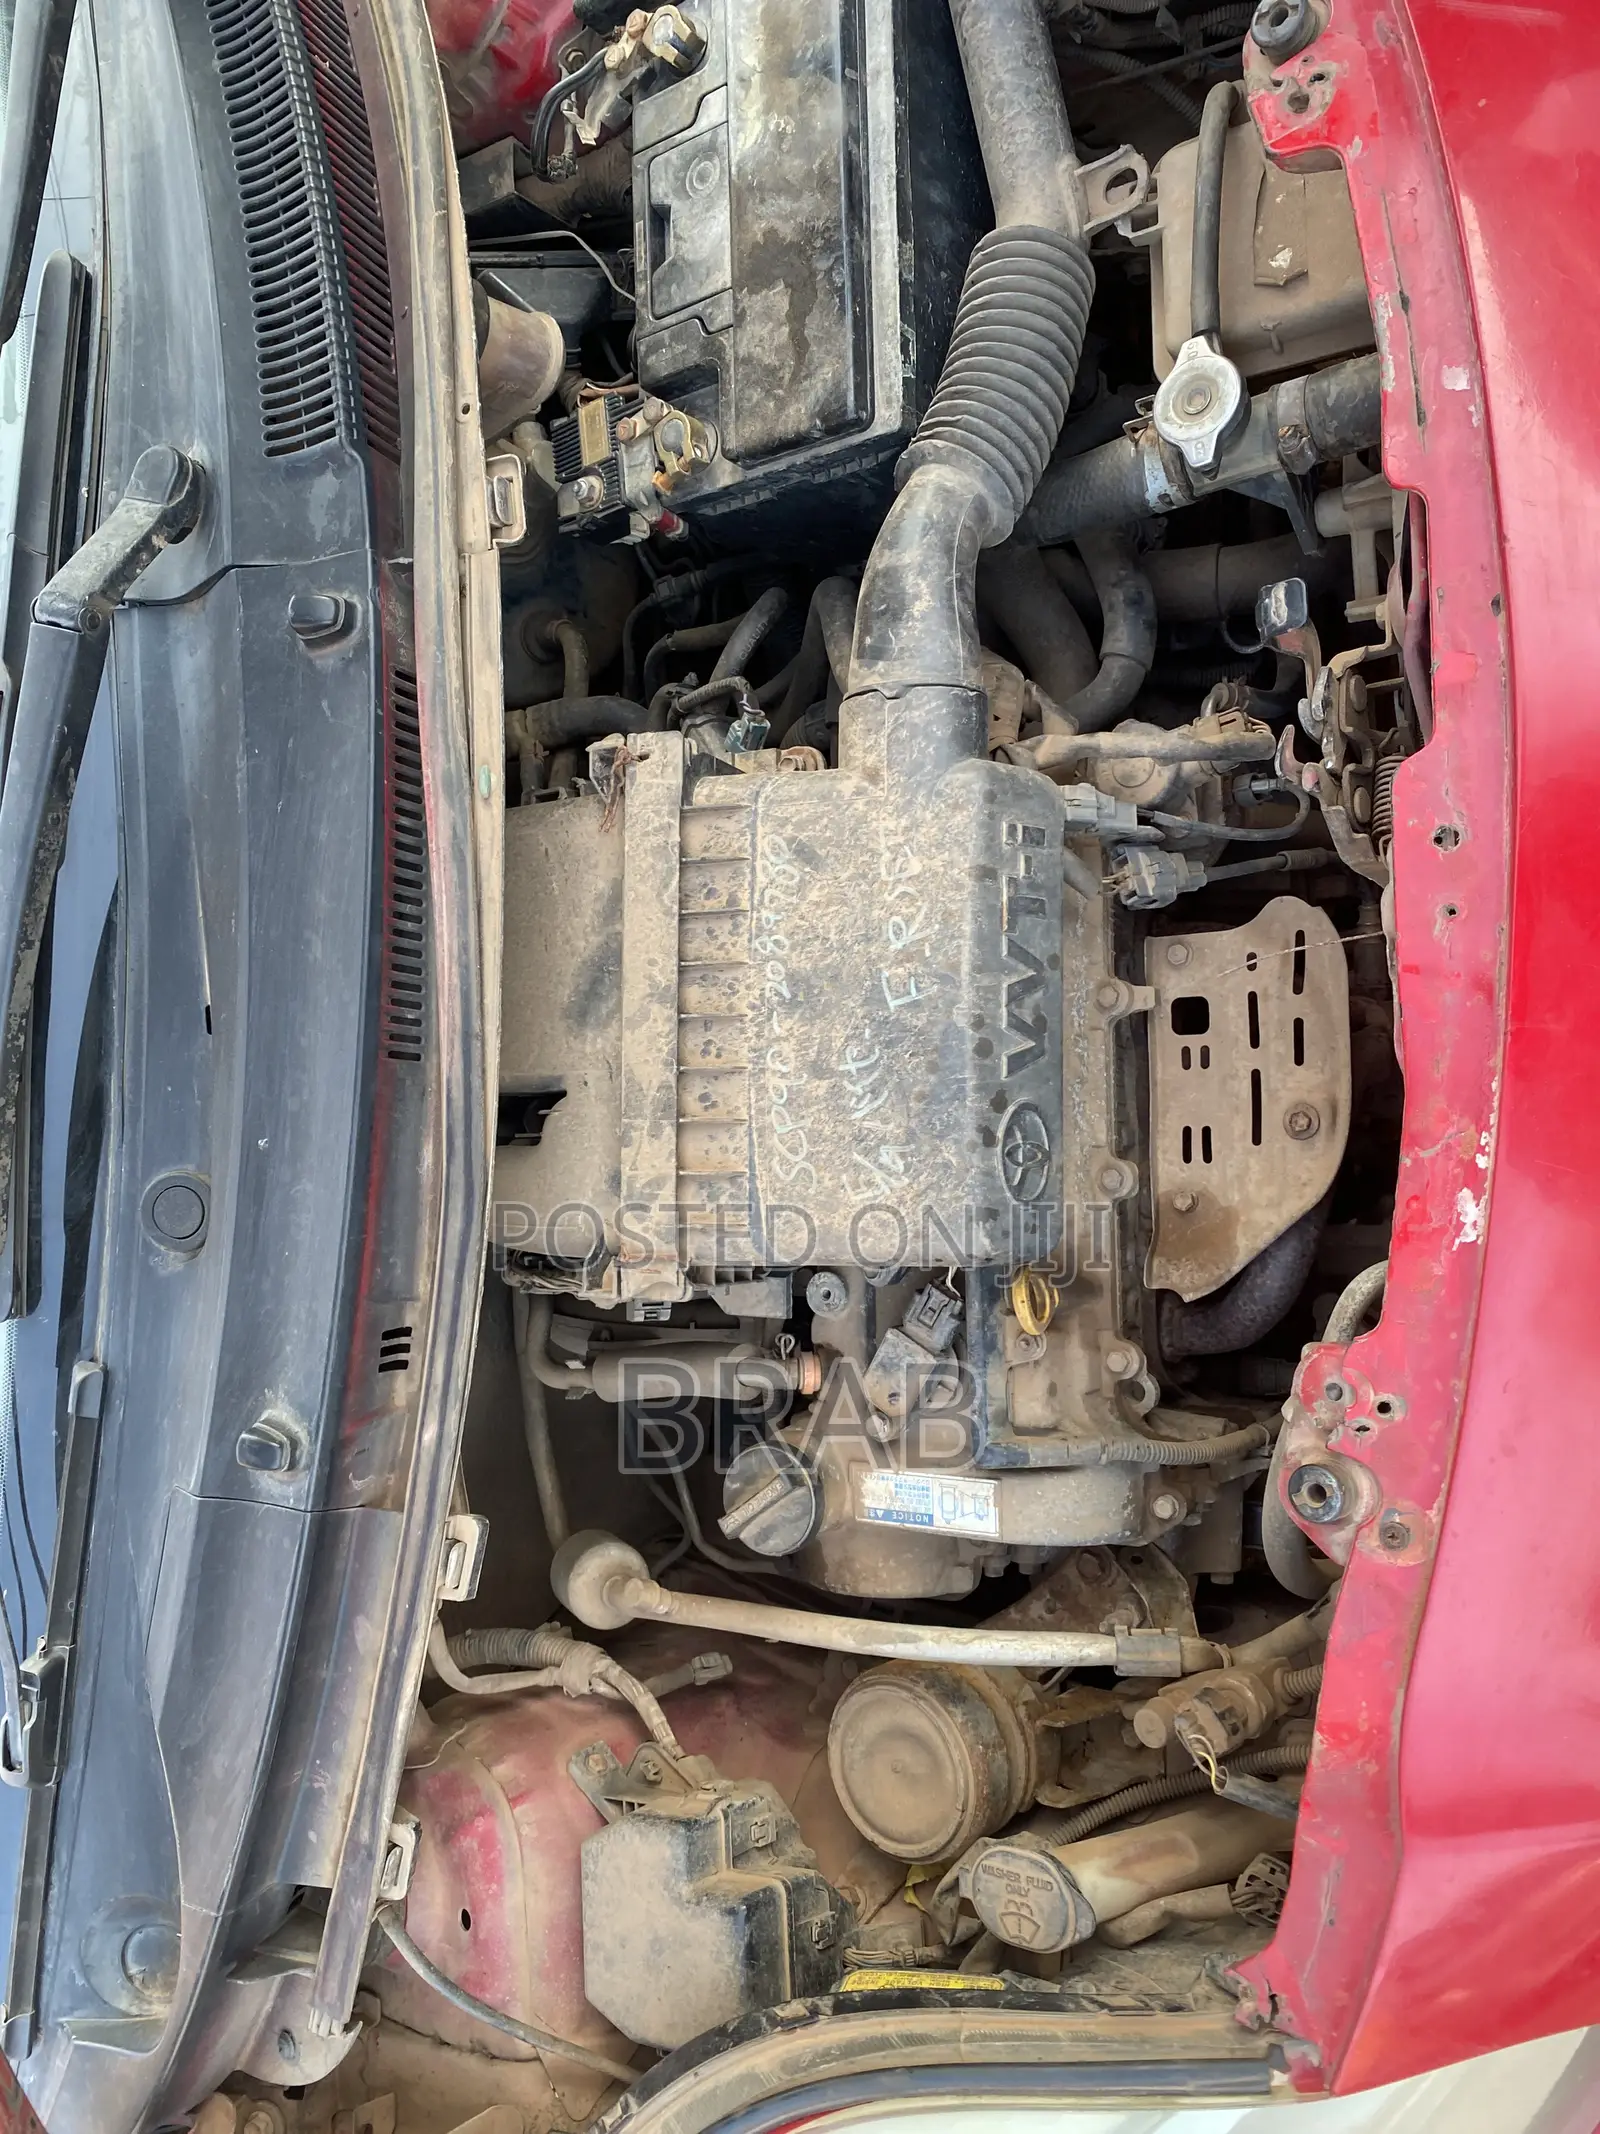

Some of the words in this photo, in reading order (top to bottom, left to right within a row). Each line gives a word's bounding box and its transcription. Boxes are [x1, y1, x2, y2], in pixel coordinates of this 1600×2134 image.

[1002, 820, 1047, 1080] VVT-i
[891, 1511, 930, 1523] NOTICE
[981, 1863, 1022, 1882] WASHER
[1025, 1875, 1054, 1892] FLUID
[1005, 1883, 1031, 1898] ONLY
